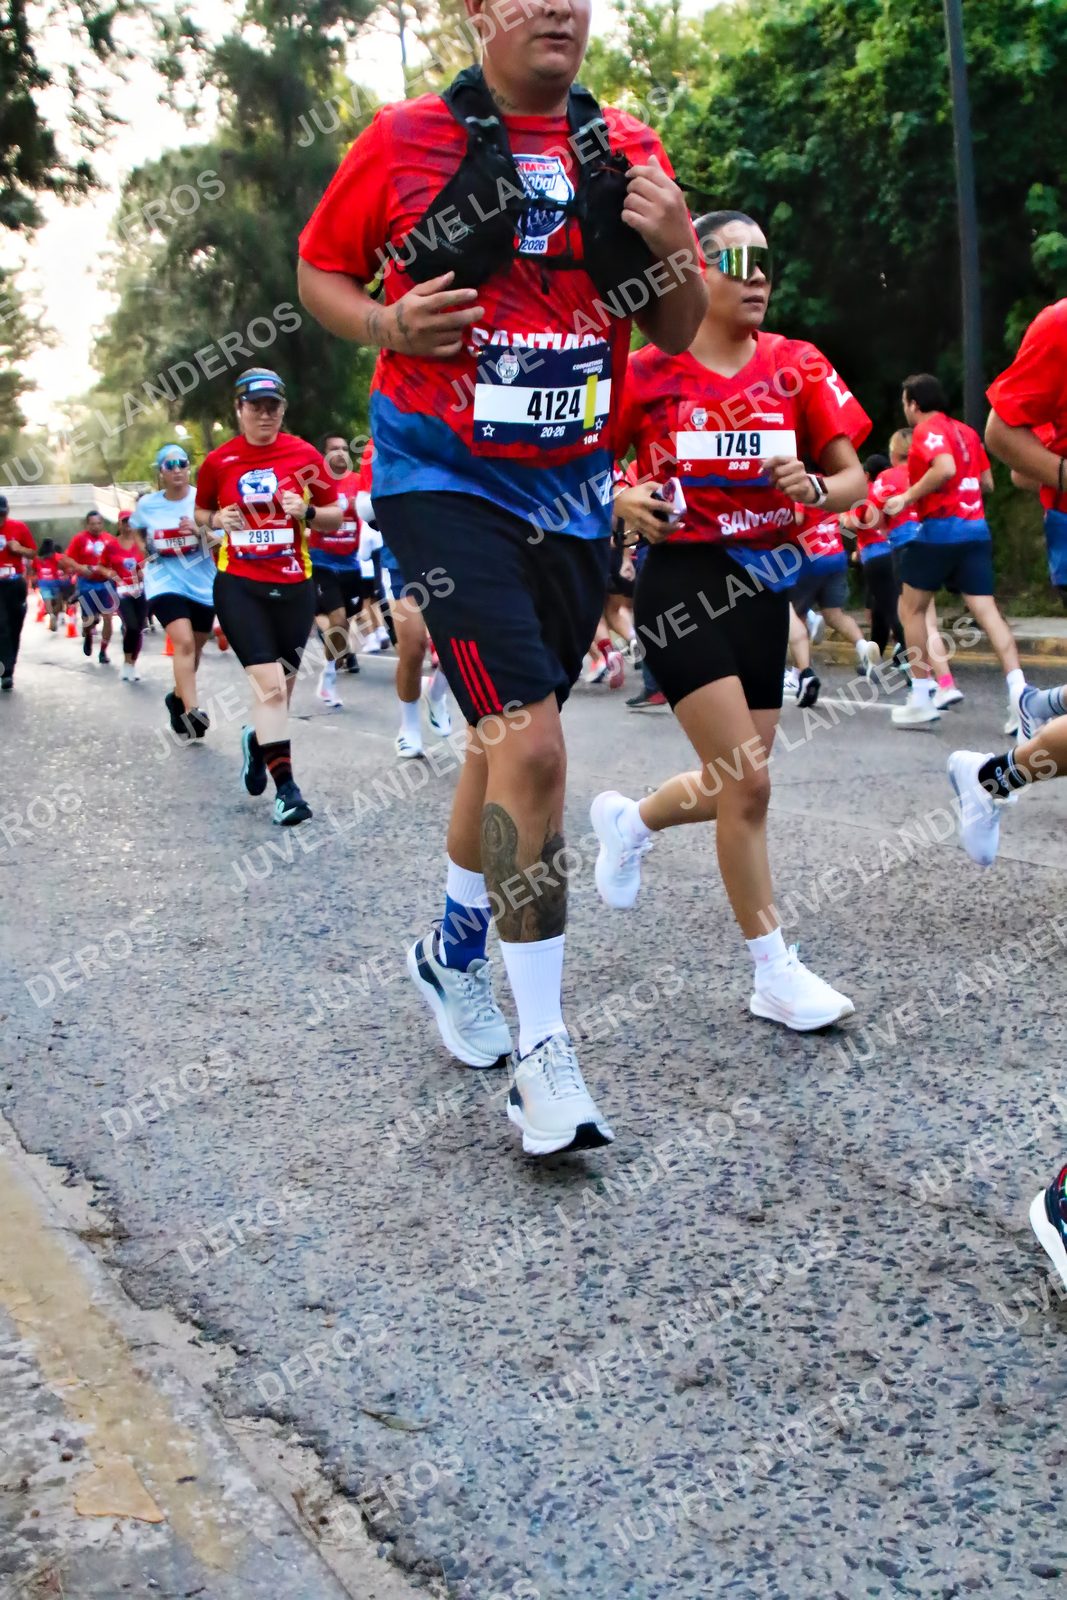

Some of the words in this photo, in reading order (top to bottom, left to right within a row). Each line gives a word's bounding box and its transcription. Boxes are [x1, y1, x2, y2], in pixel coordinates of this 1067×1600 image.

[521, 239, 546, 250] 2026
[467, 327, 608, 354] SANTIA
[527, 388, 581, 421] 4124
[540, 426, 566, 438] 20-26
[583, 433, 599, 445] 10K
[715, 432, 761, 457] 1749
[248, 530, 275, 544] 2931
